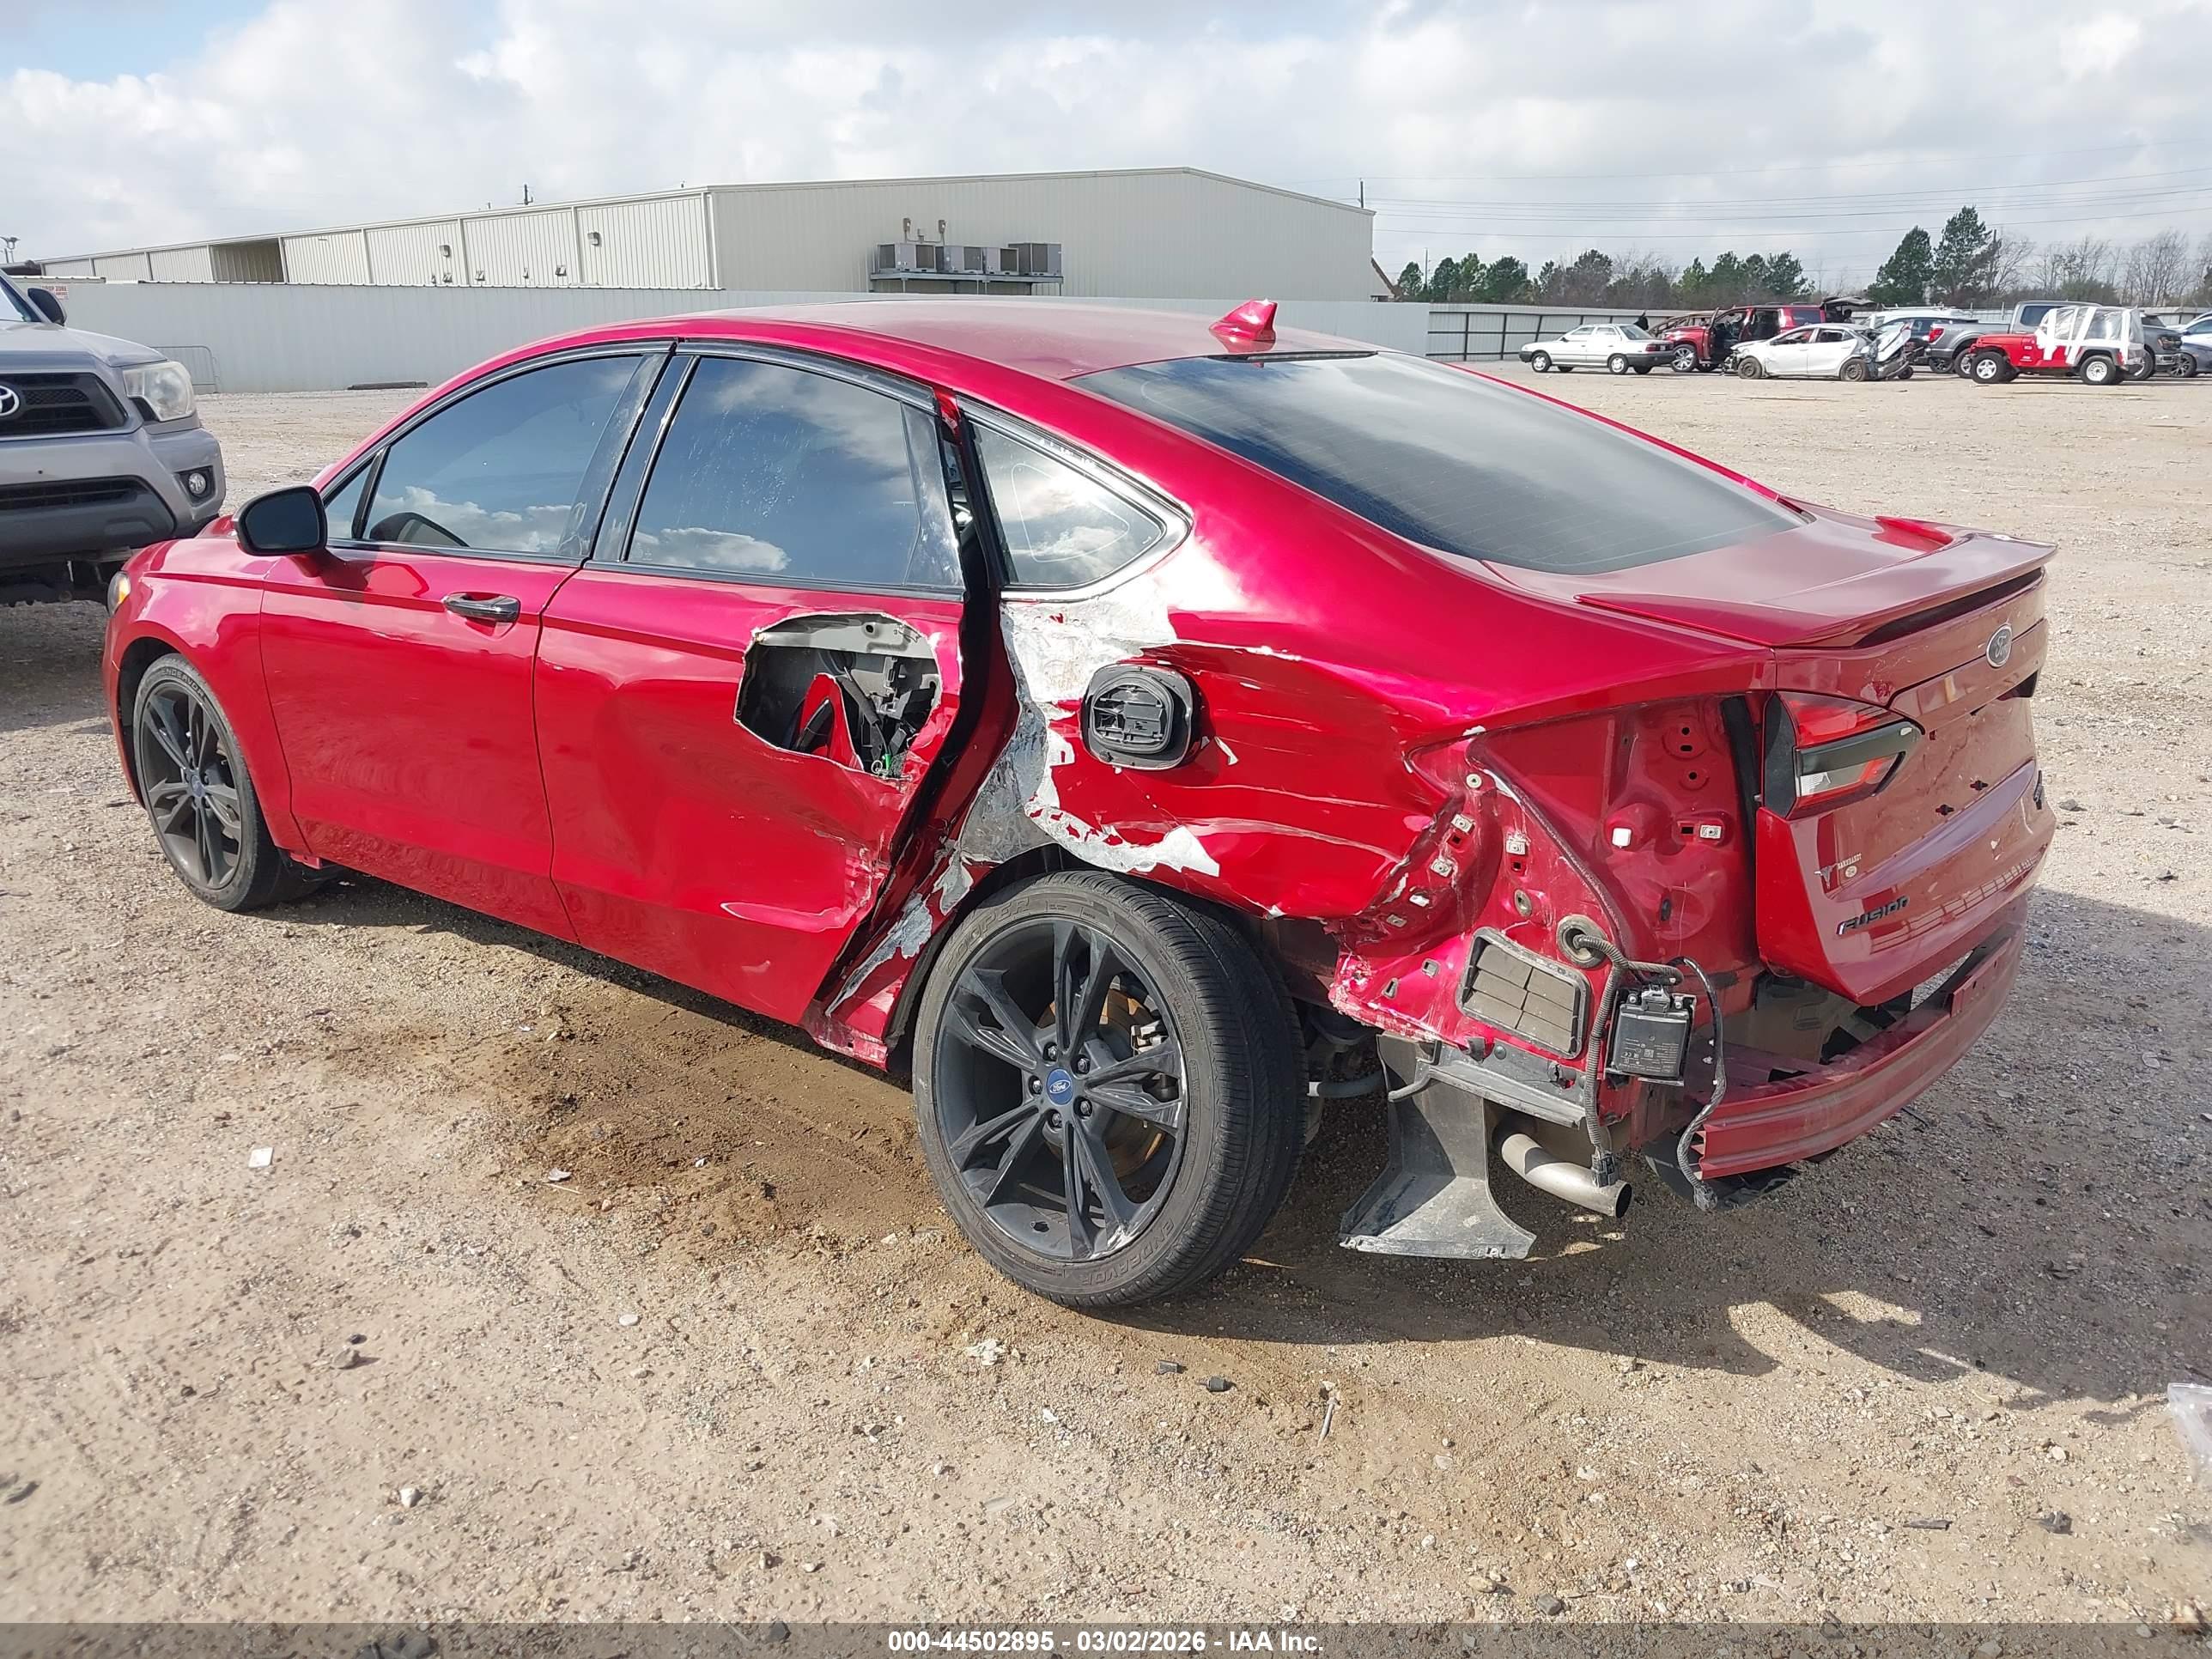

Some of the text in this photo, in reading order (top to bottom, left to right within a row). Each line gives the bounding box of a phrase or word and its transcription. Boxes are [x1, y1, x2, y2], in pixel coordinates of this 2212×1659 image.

[945, 896, 1030, 976] COOPER
[1836, 896, 1909, 935] FUSION
[1052, 1082, 1066, 1092] Ford
[1081, 1218, 1175, 1286] ENDEAVOR
